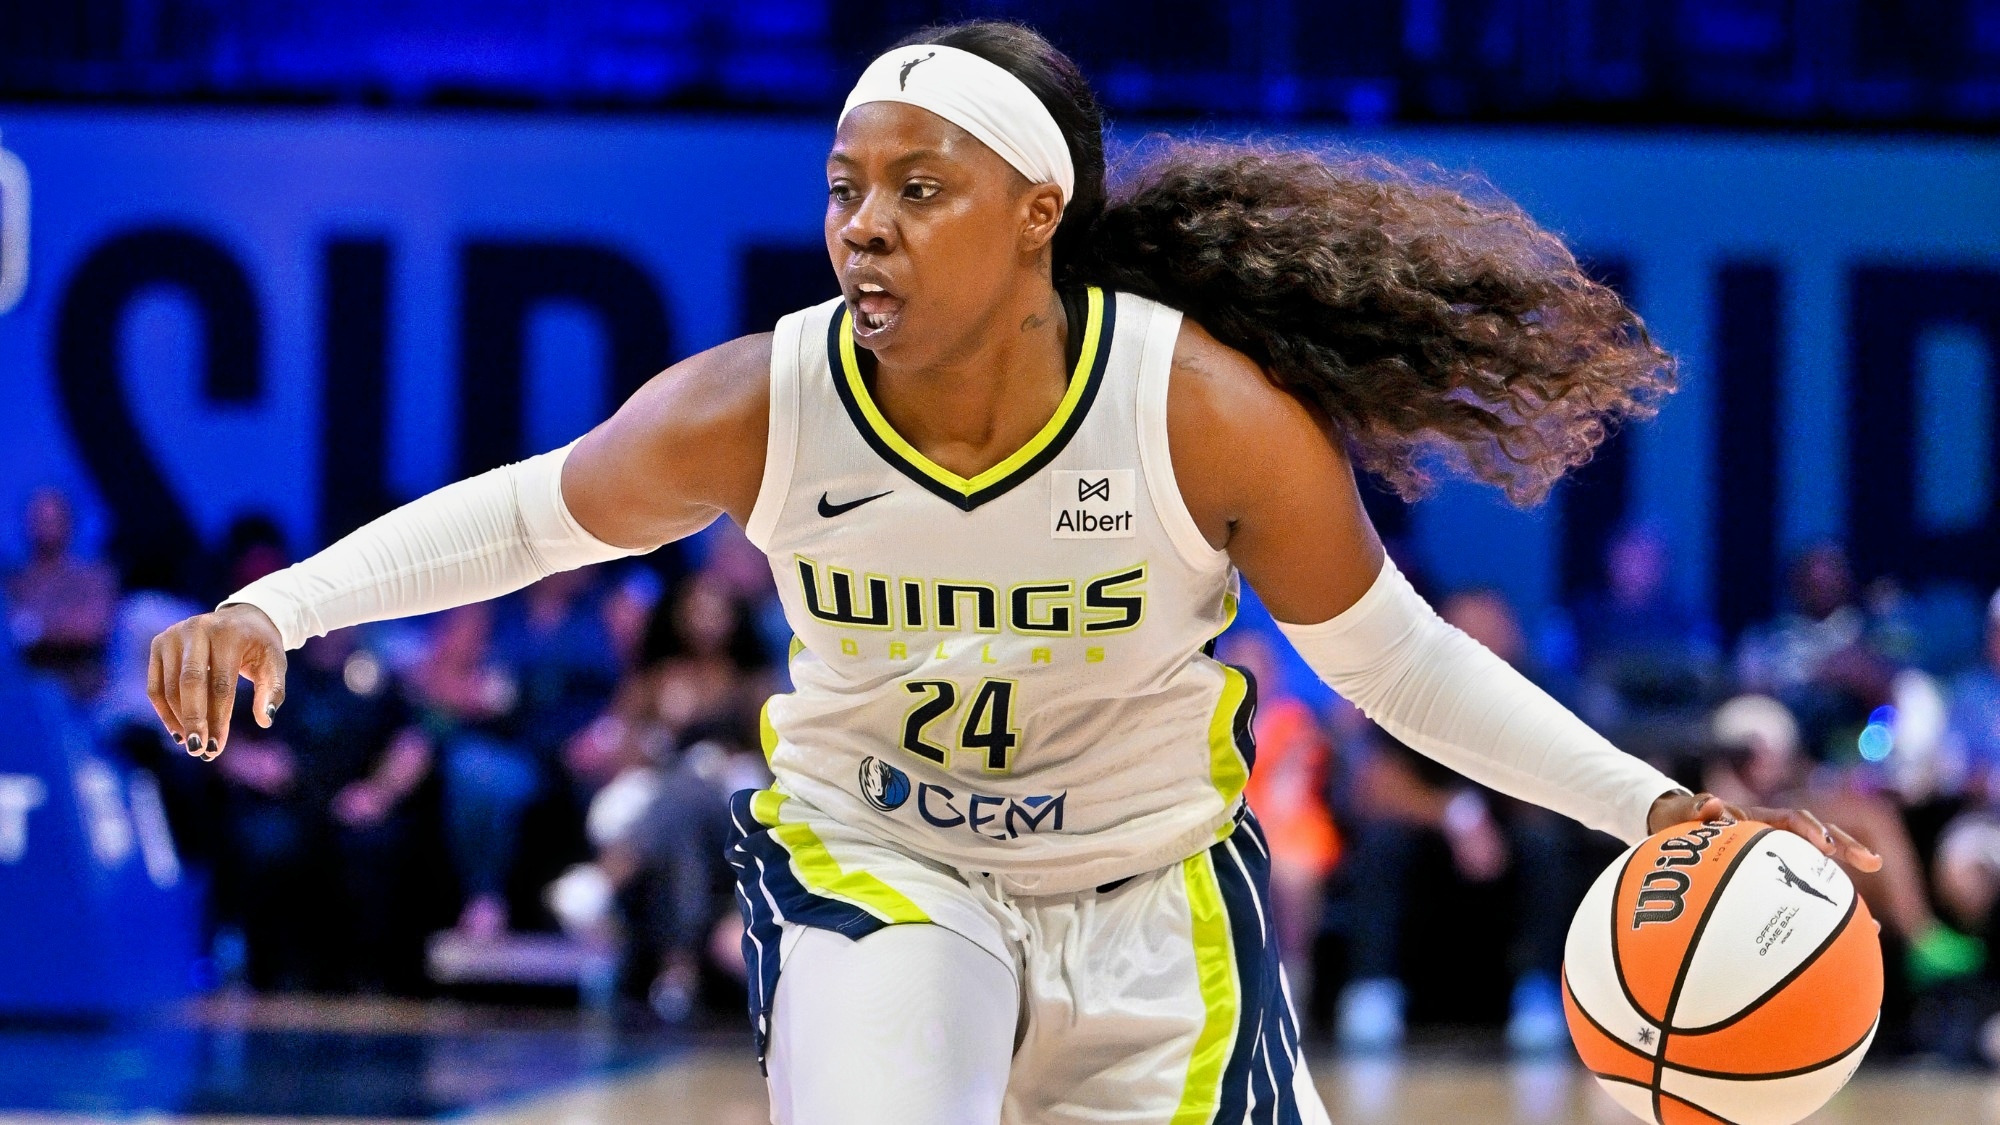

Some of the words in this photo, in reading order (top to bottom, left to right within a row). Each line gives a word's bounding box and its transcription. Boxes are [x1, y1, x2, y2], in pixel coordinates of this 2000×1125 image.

[1055, 509, 1133, 533] Albert
[793, 553, 1149, 637] WINGS
[841, 637, 1105, 664] DALLAS
[902, 677, 1021, 775] 24
[917, 782, 1068, 841] GEM
[1632, 817, 1737, 931] Wilso
[1755, 906, 1788, 944] OFFICIAL
[1759, 927, 1783, 957] GAME
[1780, 907, 1800, 929] BALL
